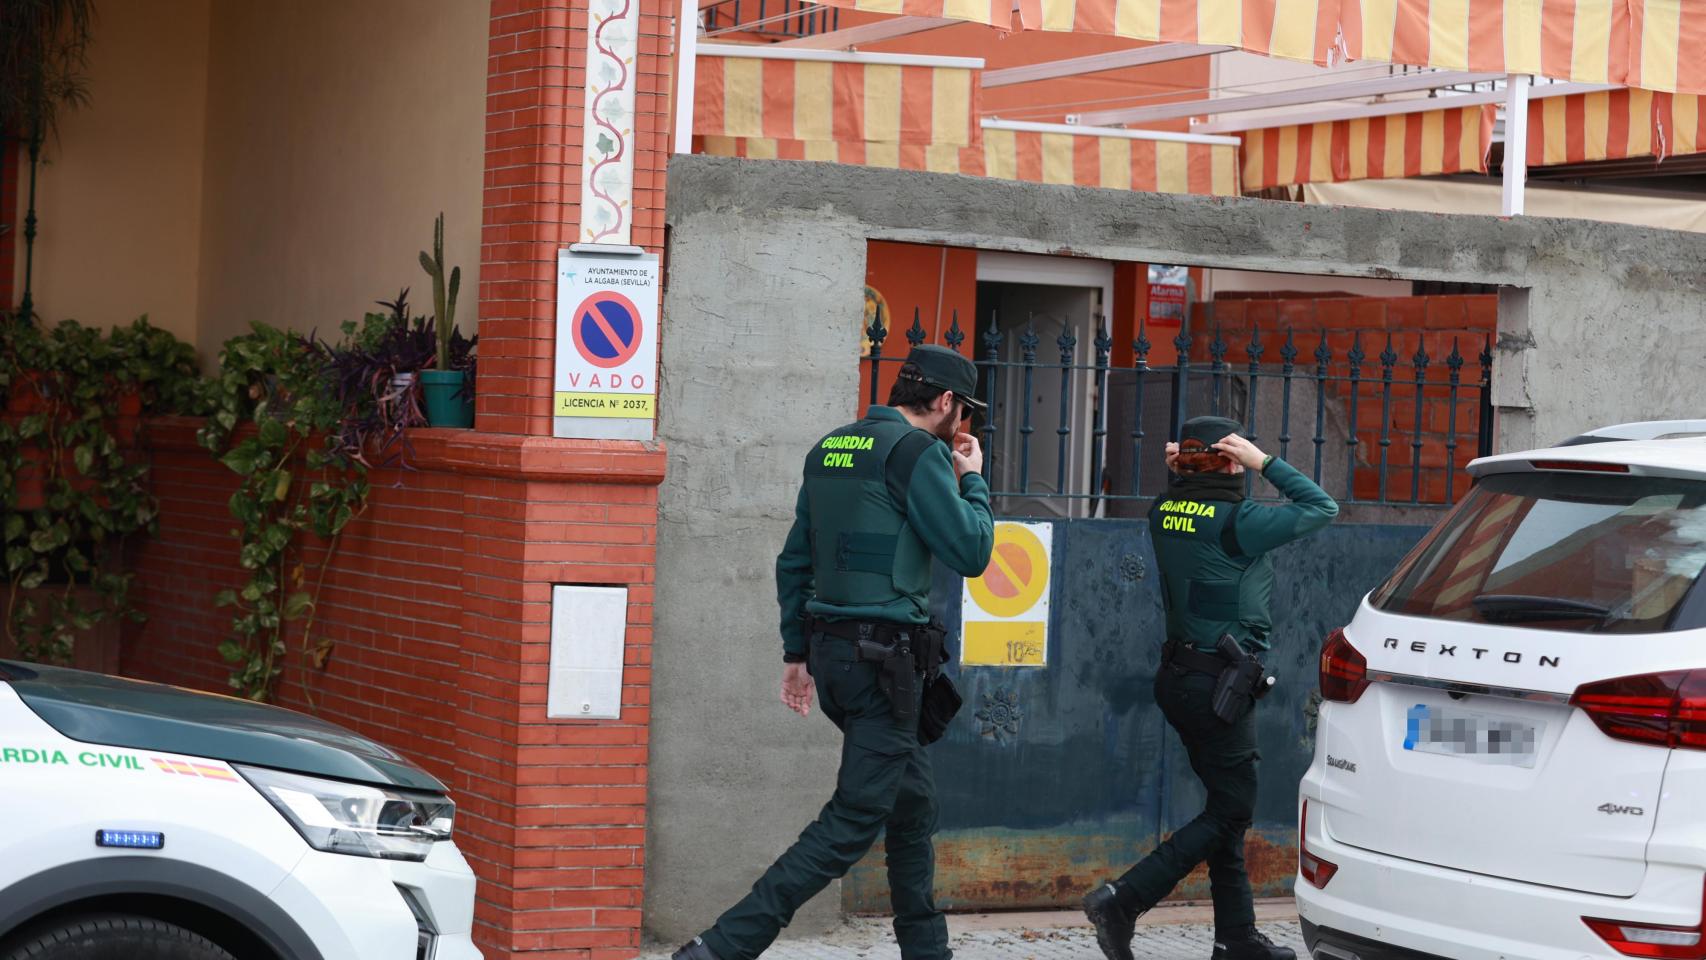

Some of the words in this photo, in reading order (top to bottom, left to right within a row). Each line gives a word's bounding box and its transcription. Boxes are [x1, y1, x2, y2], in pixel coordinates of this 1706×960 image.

[588, 267, 638, 276] AYUNTAMIENTO
[639, 269, 648, 277] DE
[594, 277, 620, 285] ALGABA
[620, 278, 651, 287] (SEVILLA)
[569, 372, 645, 390] VADO
[564, 398, 605, 408] LICENCIA
[623, 400, 647, 409] 2037
[821, 435, 875, 450] GUARDIA
[823, 452, 854, 468] CIVIL
[1159, 500, 1216, 518] GUARDIA
[1162, 515, 1196, 533] CIVIL
[1384, 637, 1560, 668] REXTON
[0, 747, 69, 765] RDIA
[78, 751, 145, 770] CIVIL
[1597, 802, 1644, 816] 4WD
